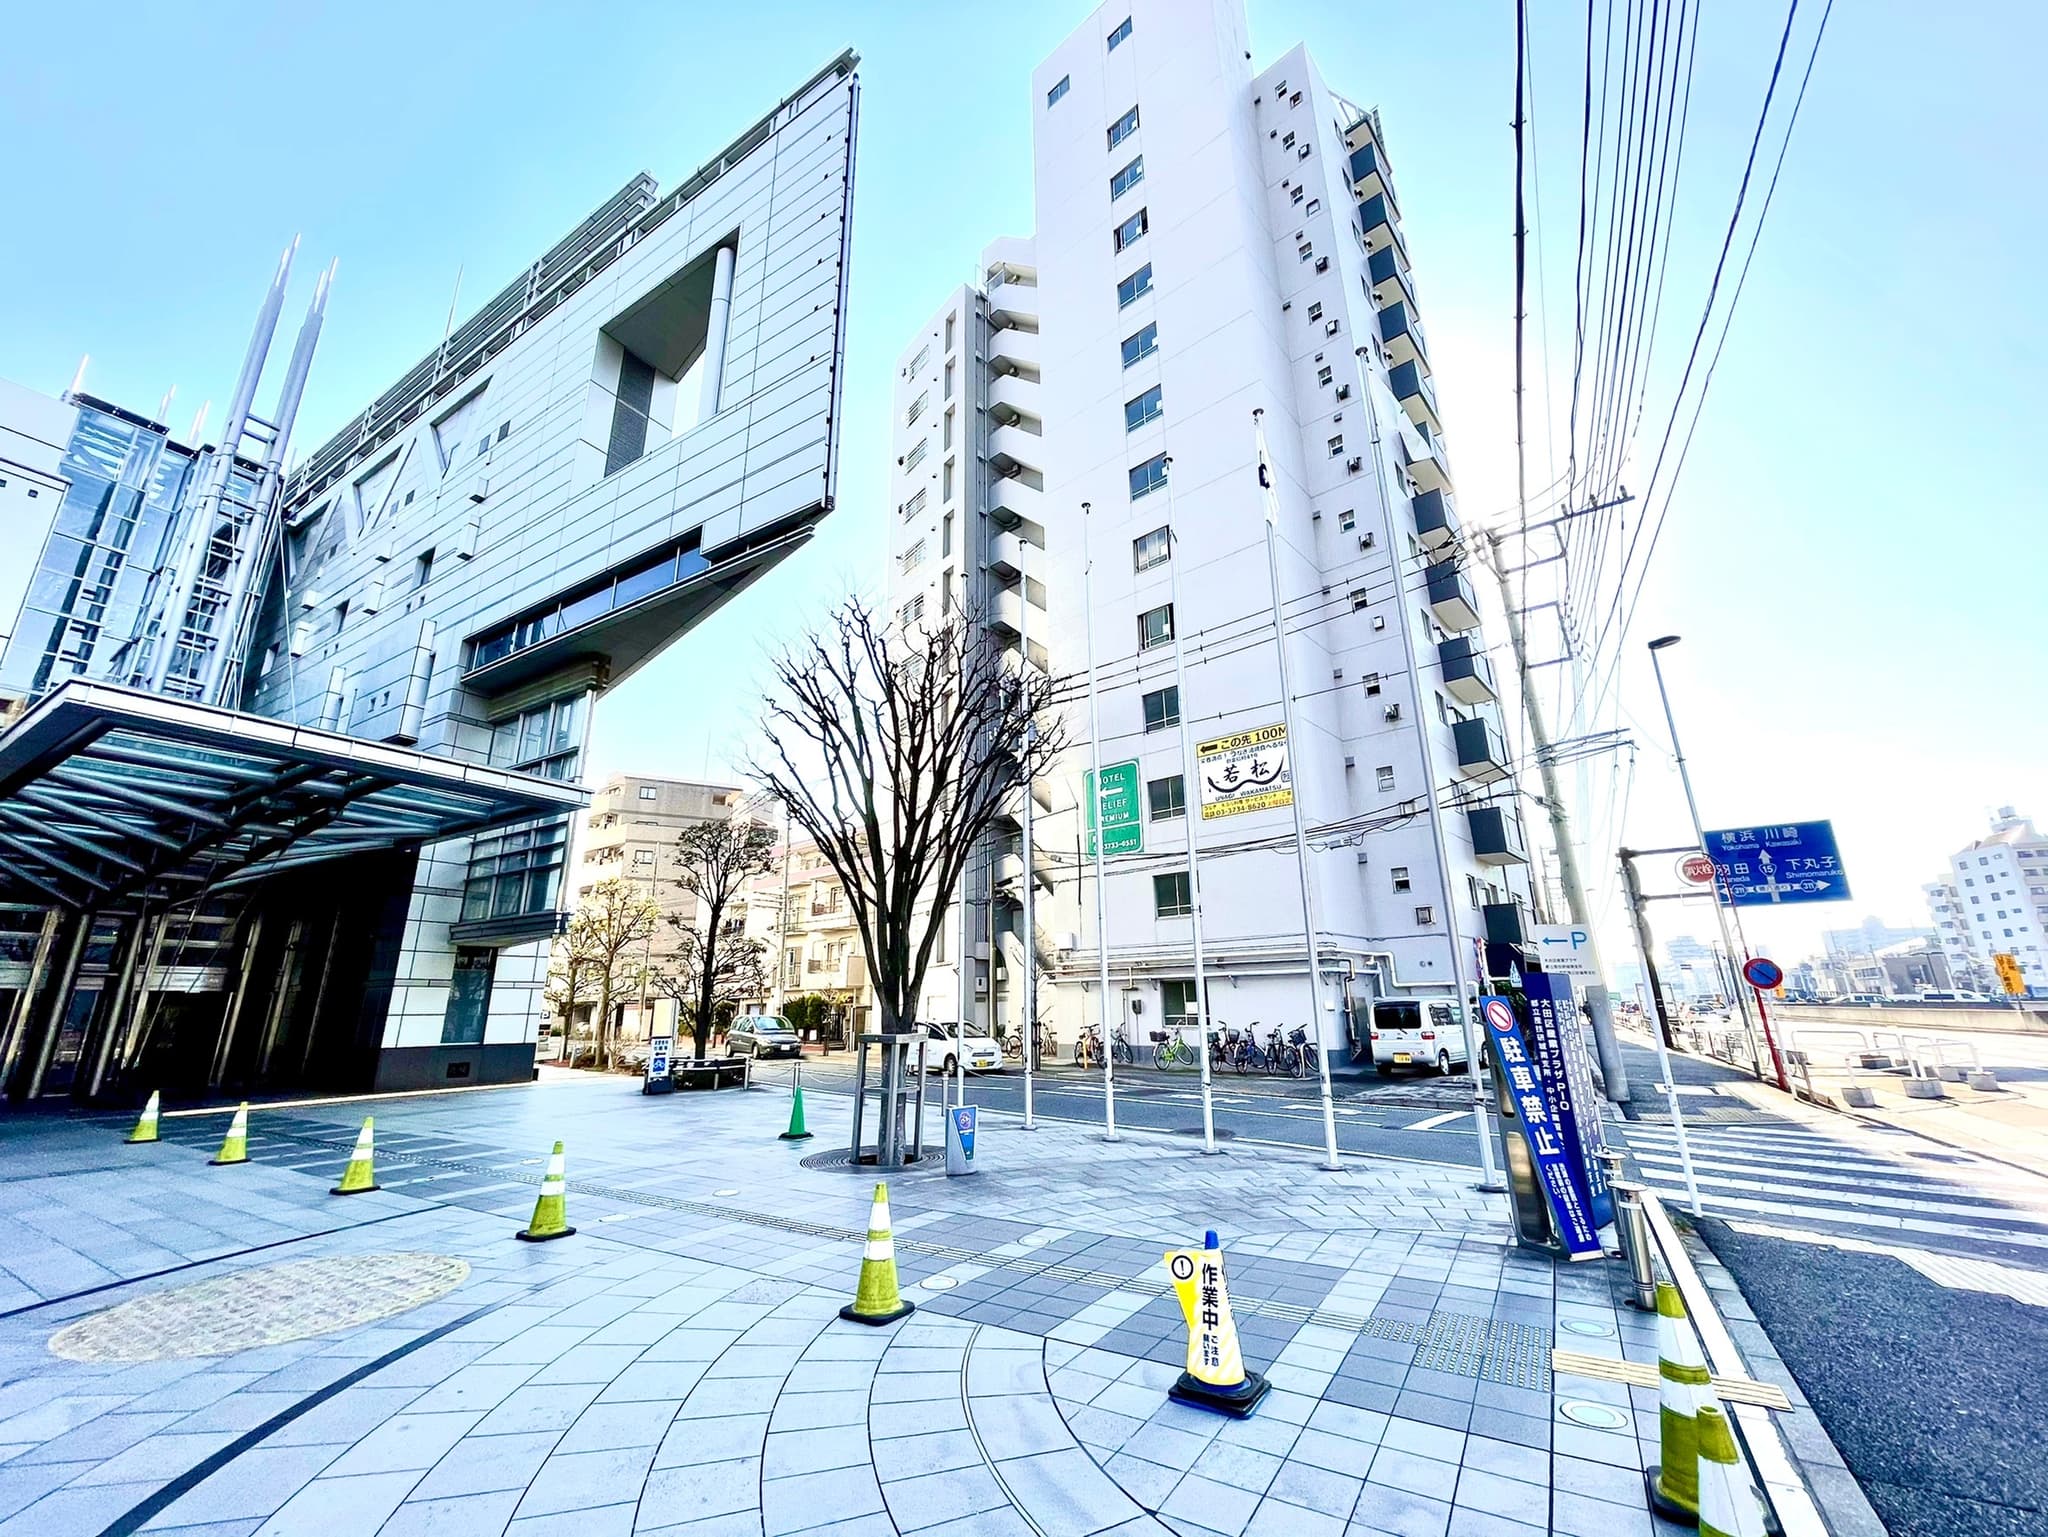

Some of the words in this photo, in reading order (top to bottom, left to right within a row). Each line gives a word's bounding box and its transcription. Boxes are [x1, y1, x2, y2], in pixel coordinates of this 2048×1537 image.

[1221, 734, 1252, 750] この先
[1100, 773, 1125, 784] OTEL
[1223, 759, 1270, 783] 若松
[1102, 799, 1127, 811] ELIEF
[1721, 830, 1756, 844] 横浜
[1764, 827, 1798, 840] 川崎
[1721, 843, 1760, 851] Yokohama
[1765, 839, 1801, 848] Kawasaki
[1785, 856, 1837, 870] 下丸子
[1785, 869, 1843, 879] Shimomaruko
[1571, 932, 1587, 950] P
[1499, 1036, 1561, 1156] 駐車禁止
[1202, 1263, 1219, 1331] 作業中
